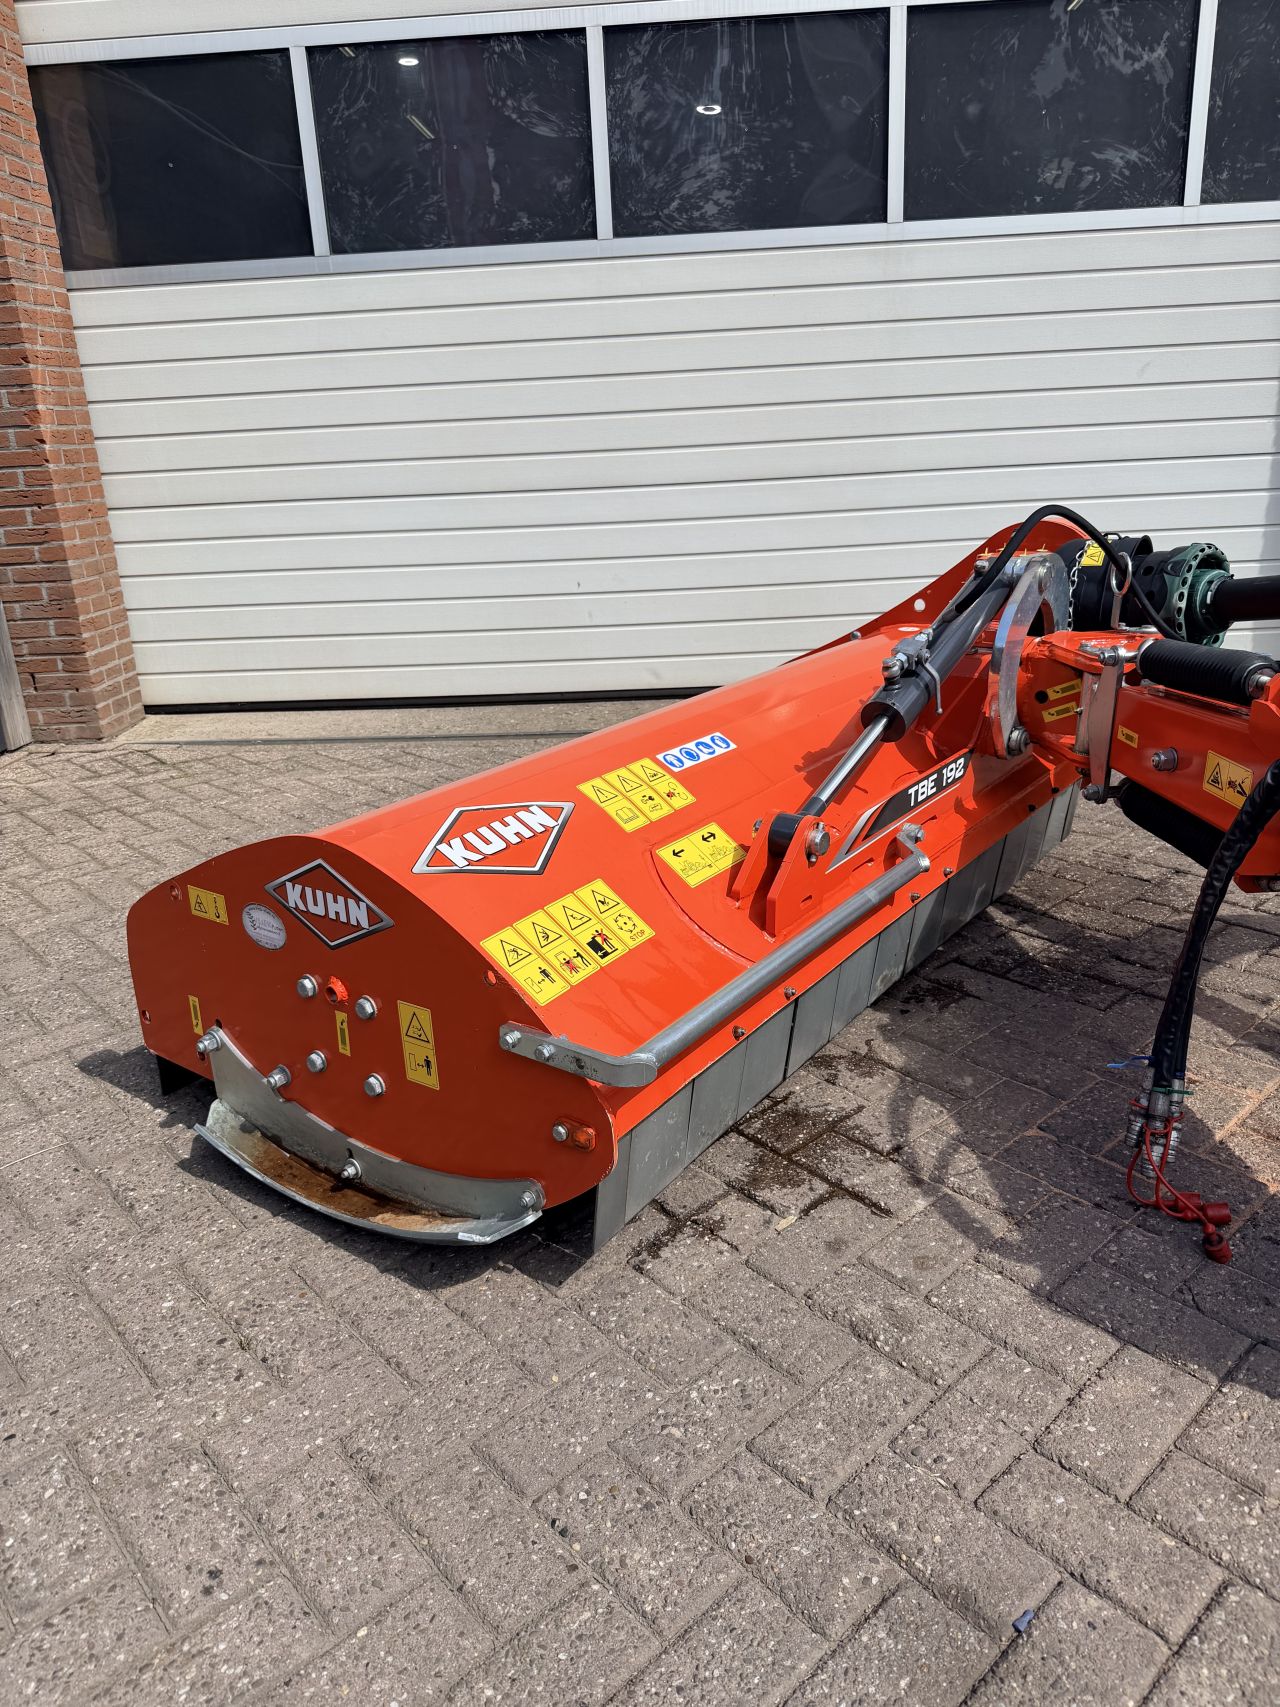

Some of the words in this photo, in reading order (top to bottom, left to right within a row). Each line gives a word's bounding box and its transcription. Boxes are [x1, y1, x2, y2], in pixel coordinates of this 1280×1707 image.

[908, 773, 938, 807] TBE
[942, 757, 965, 787] 192
[436, 805, 559, 868] KUHN
[286, 881, 369, 929] KUHN
[629, 929, 646, 942] STOP
